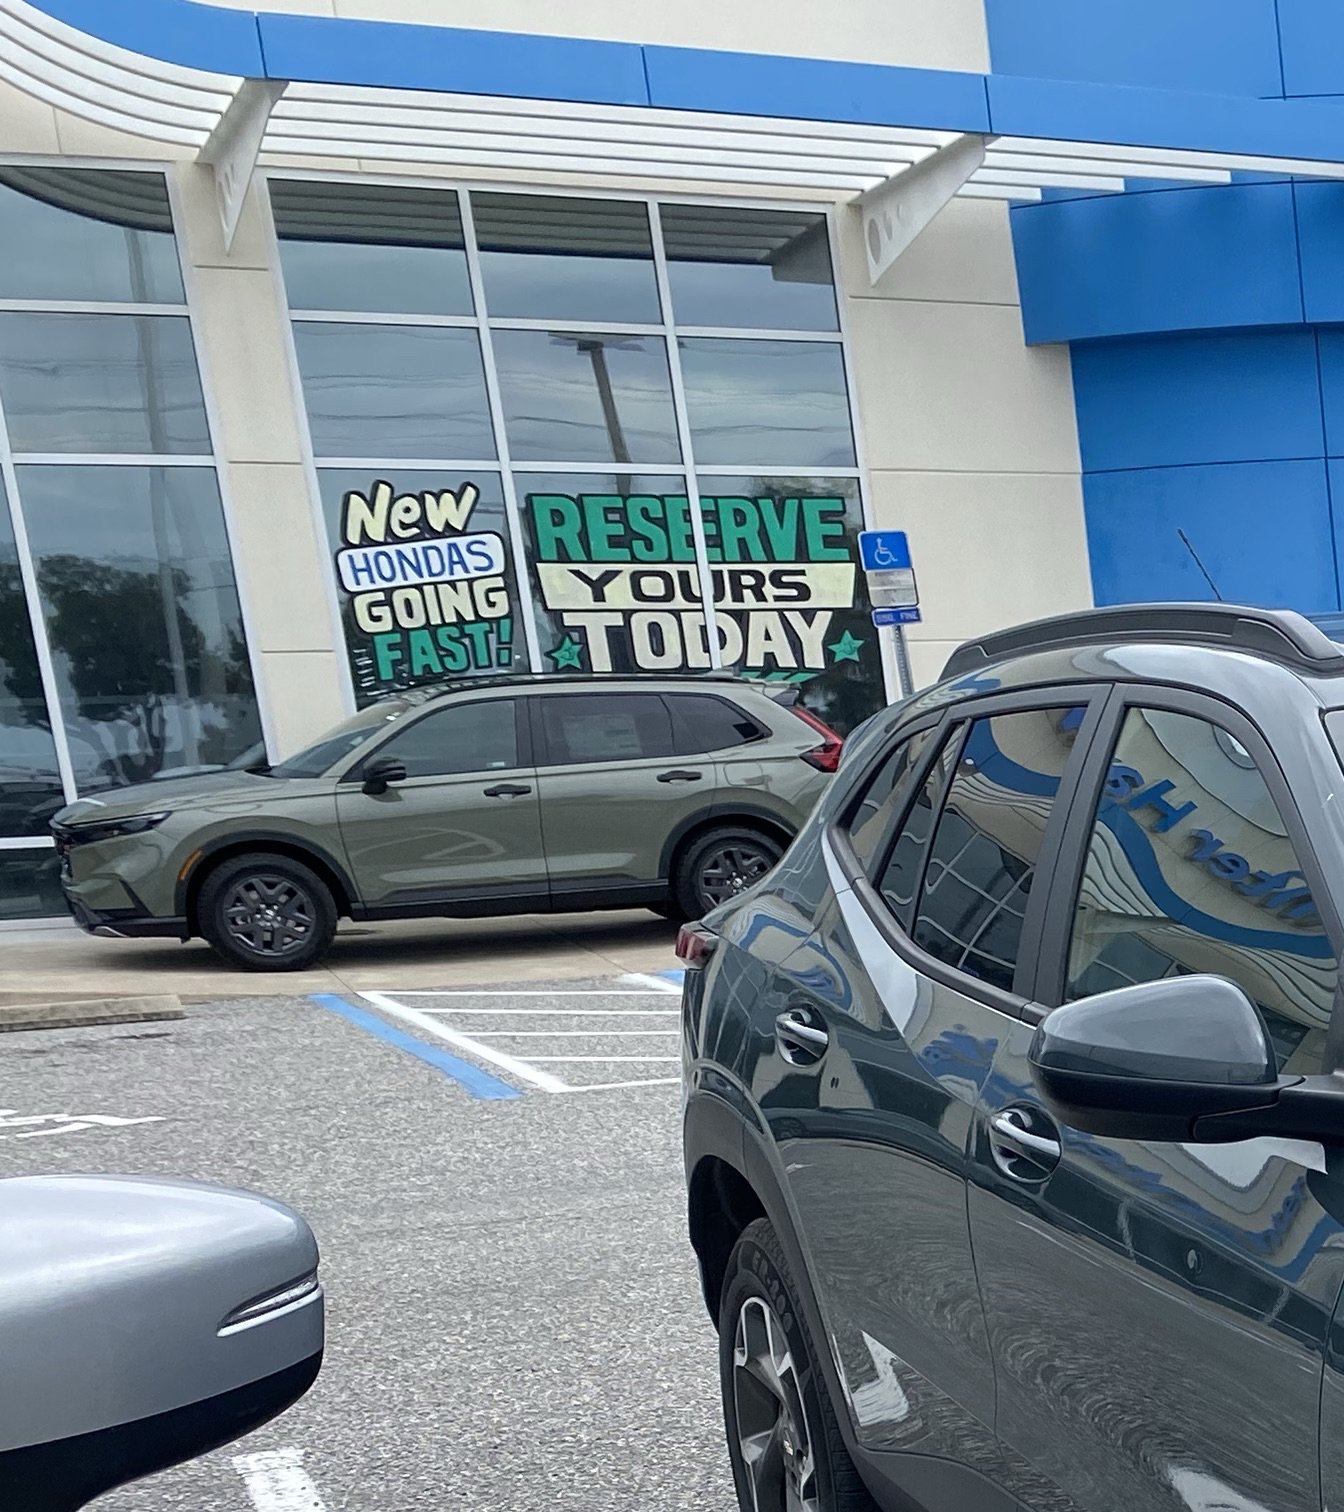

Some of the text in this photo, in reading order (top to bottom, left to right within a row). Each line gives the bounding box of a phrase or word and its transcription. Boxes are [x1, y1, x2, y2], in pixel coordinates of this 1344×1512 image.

[345, 481, 479, 545] New
[531, 495, 851, 562] RESERVE
[348, 539, 495, 587] HONDAS
[567, 569, 812, 604] YOURS
[353, 576, 511, 634] GOING
[373, 617, 513, 681] FAST!
[562, 611, 834, 672] TODAY
